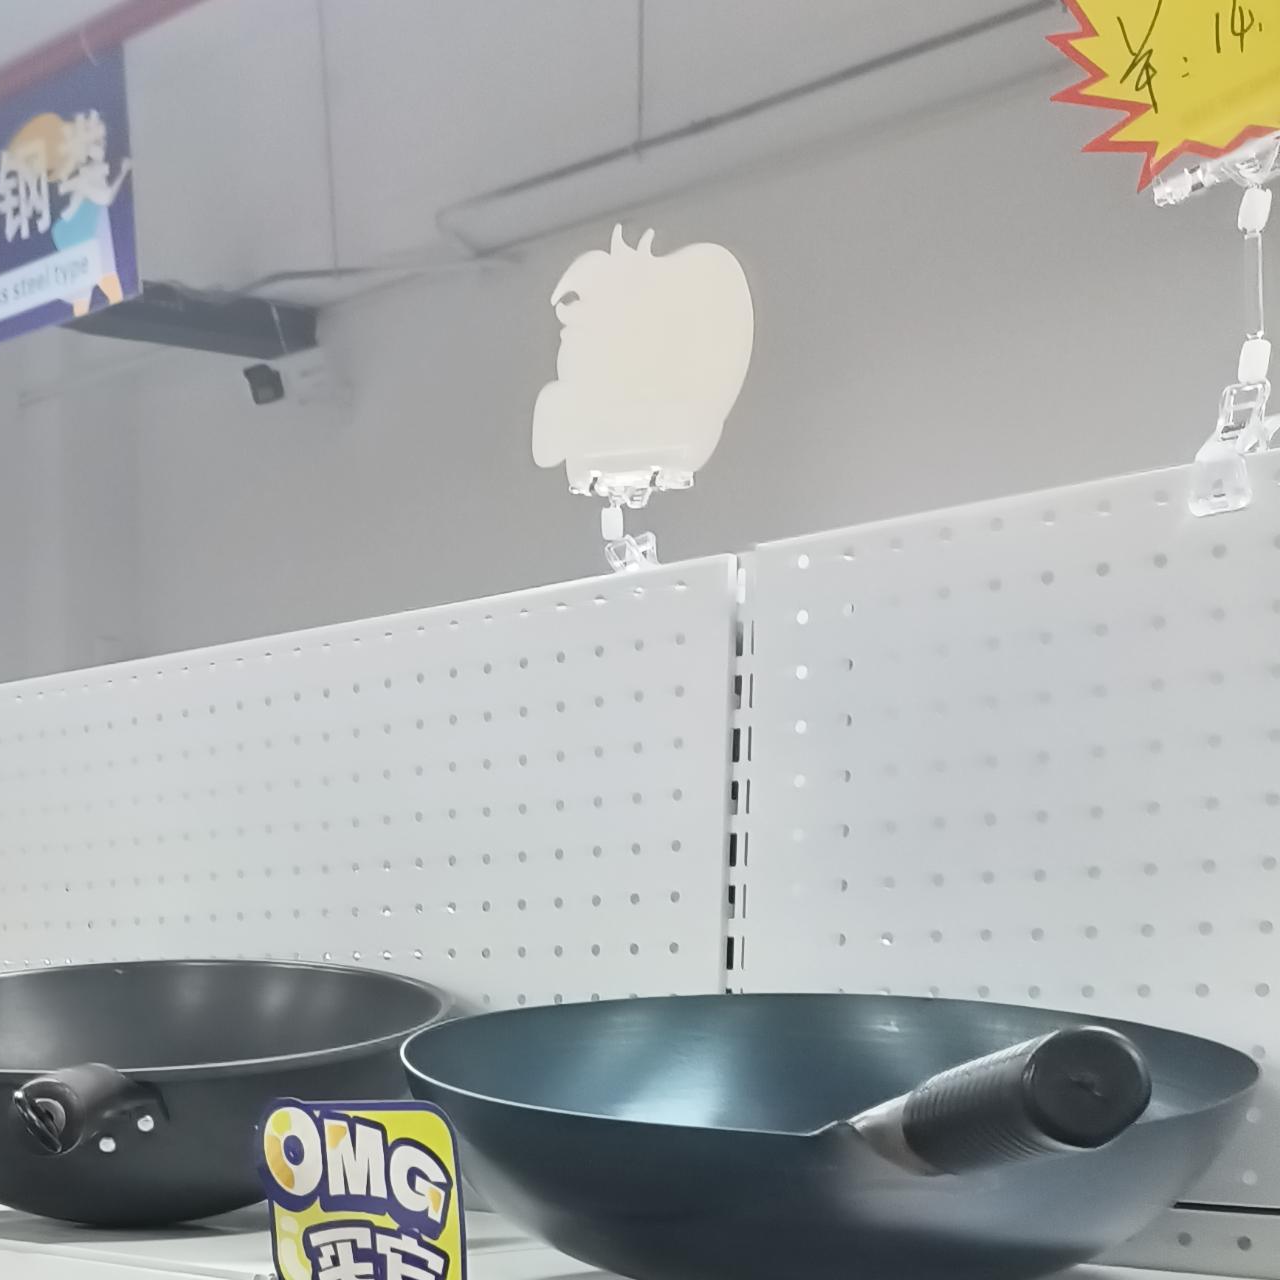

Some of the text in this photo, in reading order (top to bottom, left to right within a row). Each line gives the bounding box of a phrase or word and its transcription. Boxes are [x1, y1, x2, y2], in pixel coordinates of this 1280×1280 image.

[13, 266, 50, 297] steel
[54, 255, 89, 286] type
[263, 1106, 448, 1223] OMG
